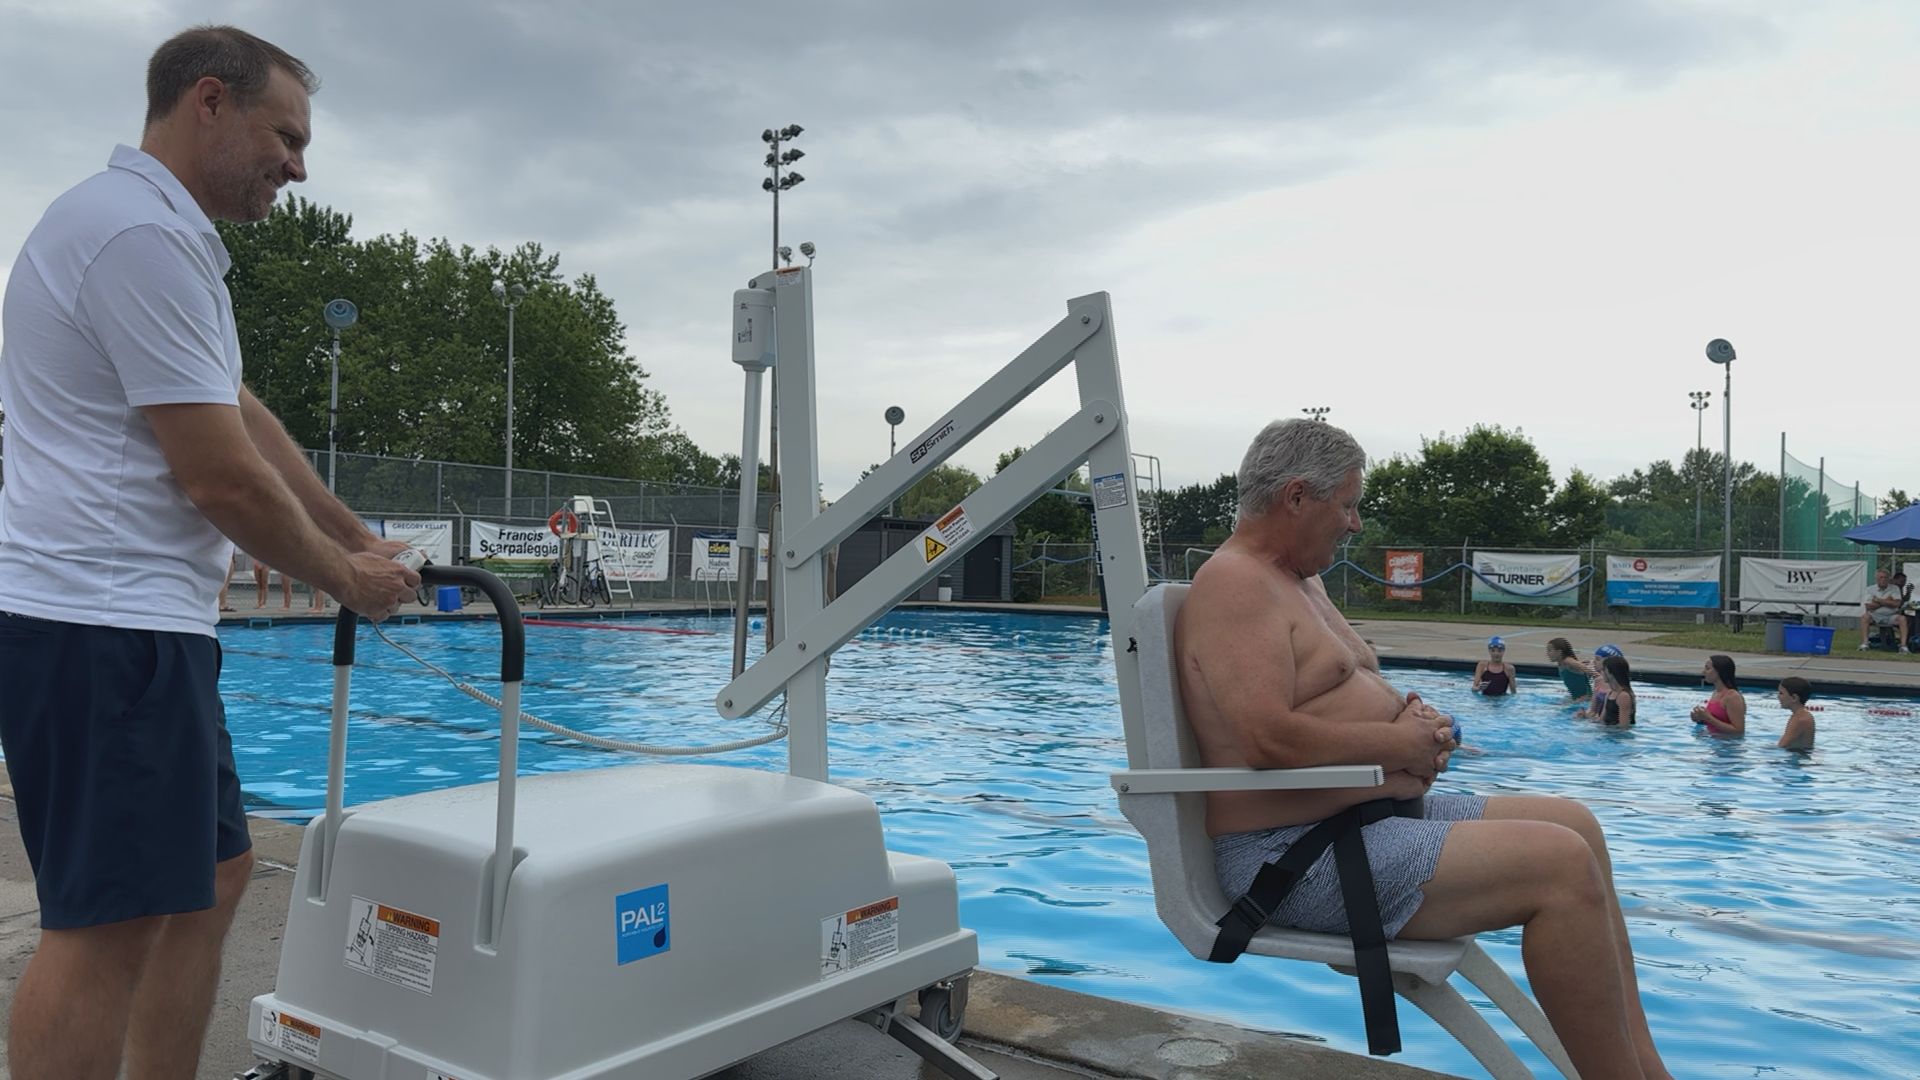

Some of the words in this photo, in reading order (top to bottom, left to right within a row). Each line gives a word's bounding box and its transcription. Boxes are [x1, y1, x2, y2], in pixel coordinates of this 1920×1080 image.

[498, 529, 544, 541] Francis
[480, 539, 558, 557] Scarpaleggia
[1498, 573, 1545, 586] TURNER
[1786, 570, 1817, 584] BW
[393, 911, 430, 932] WARNING
[385, 923, 406, 937] TIPPING
[406, 930, 430, 944] HAZARD
